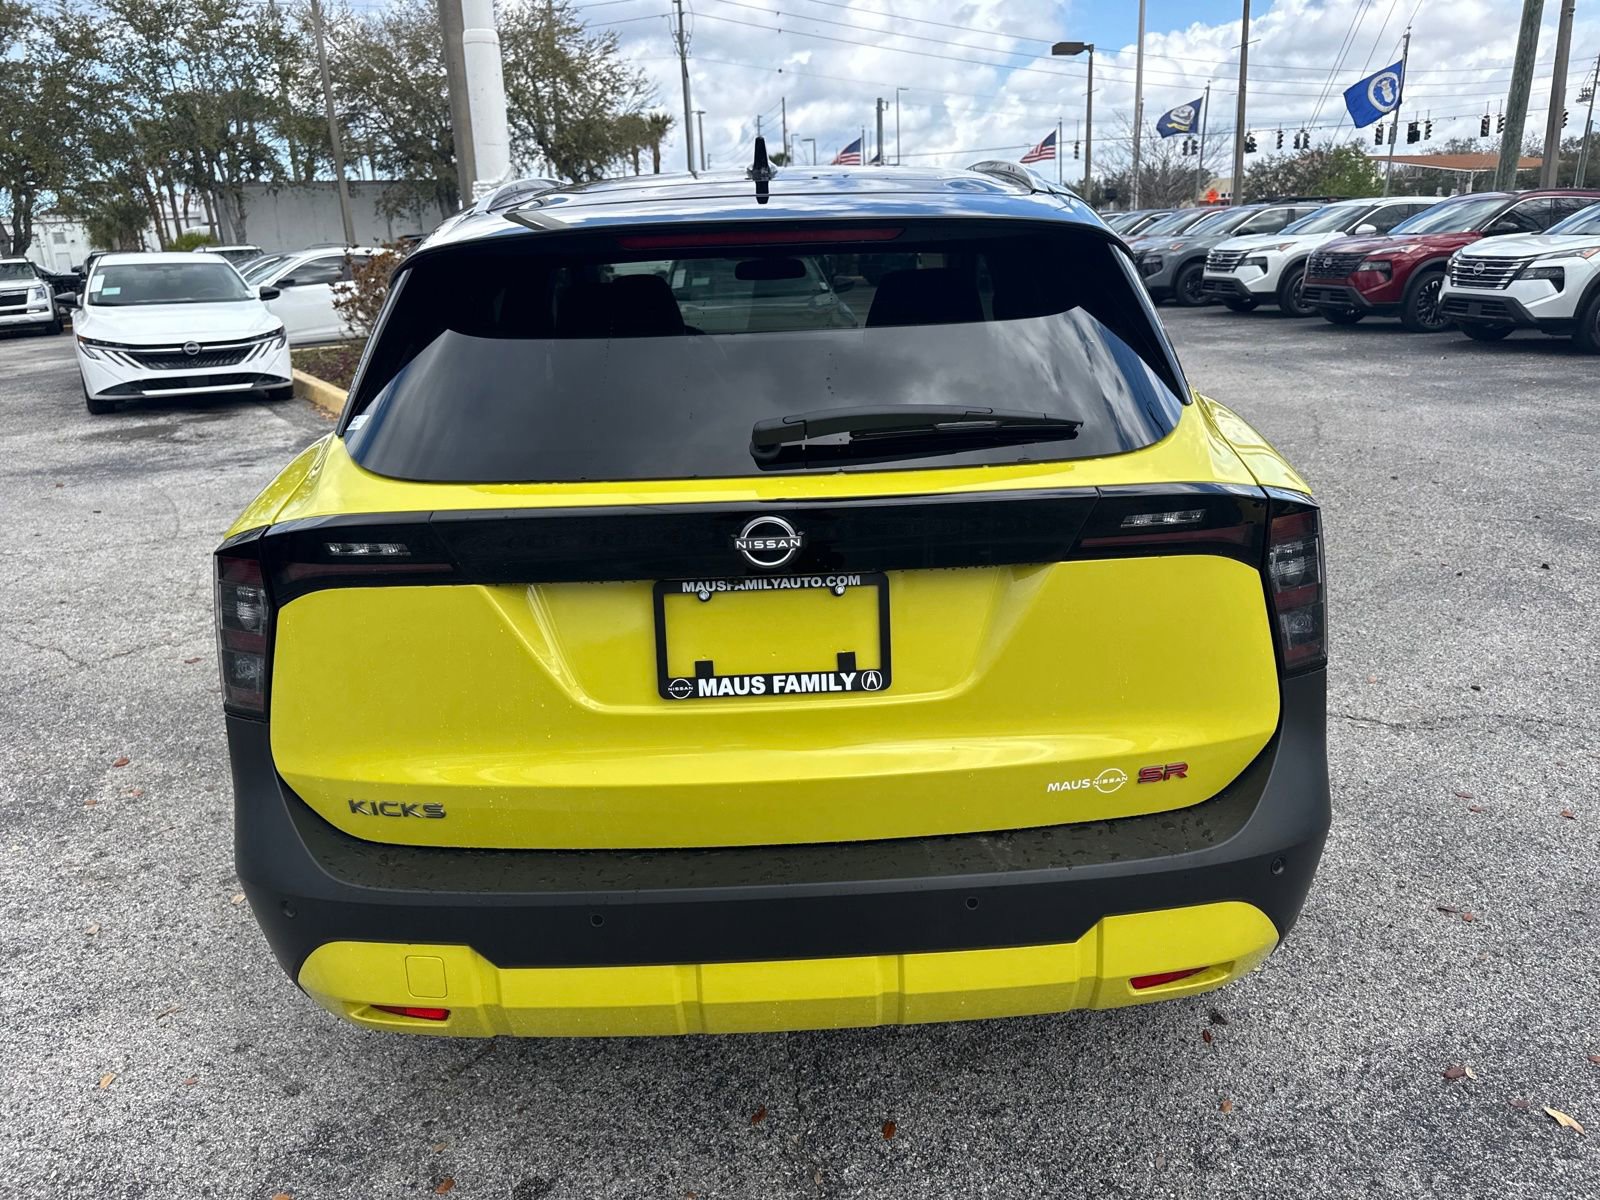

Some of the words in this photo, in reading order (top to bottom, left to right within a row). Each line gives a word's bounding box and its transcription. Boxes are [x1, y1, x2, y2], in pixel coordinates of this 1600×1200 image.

[736, 538, 801, 550] NISSAN
[698, 677, 766, 697] MAUS
[772, 672, 856, 694] FAMILY
[1136, 761, 1189, 784] SR
[1047, 778, 1091, 793] MAUS
[1092, 775, 1128, 787] NISSAN
[348, 799, 447, 818] KICKS
